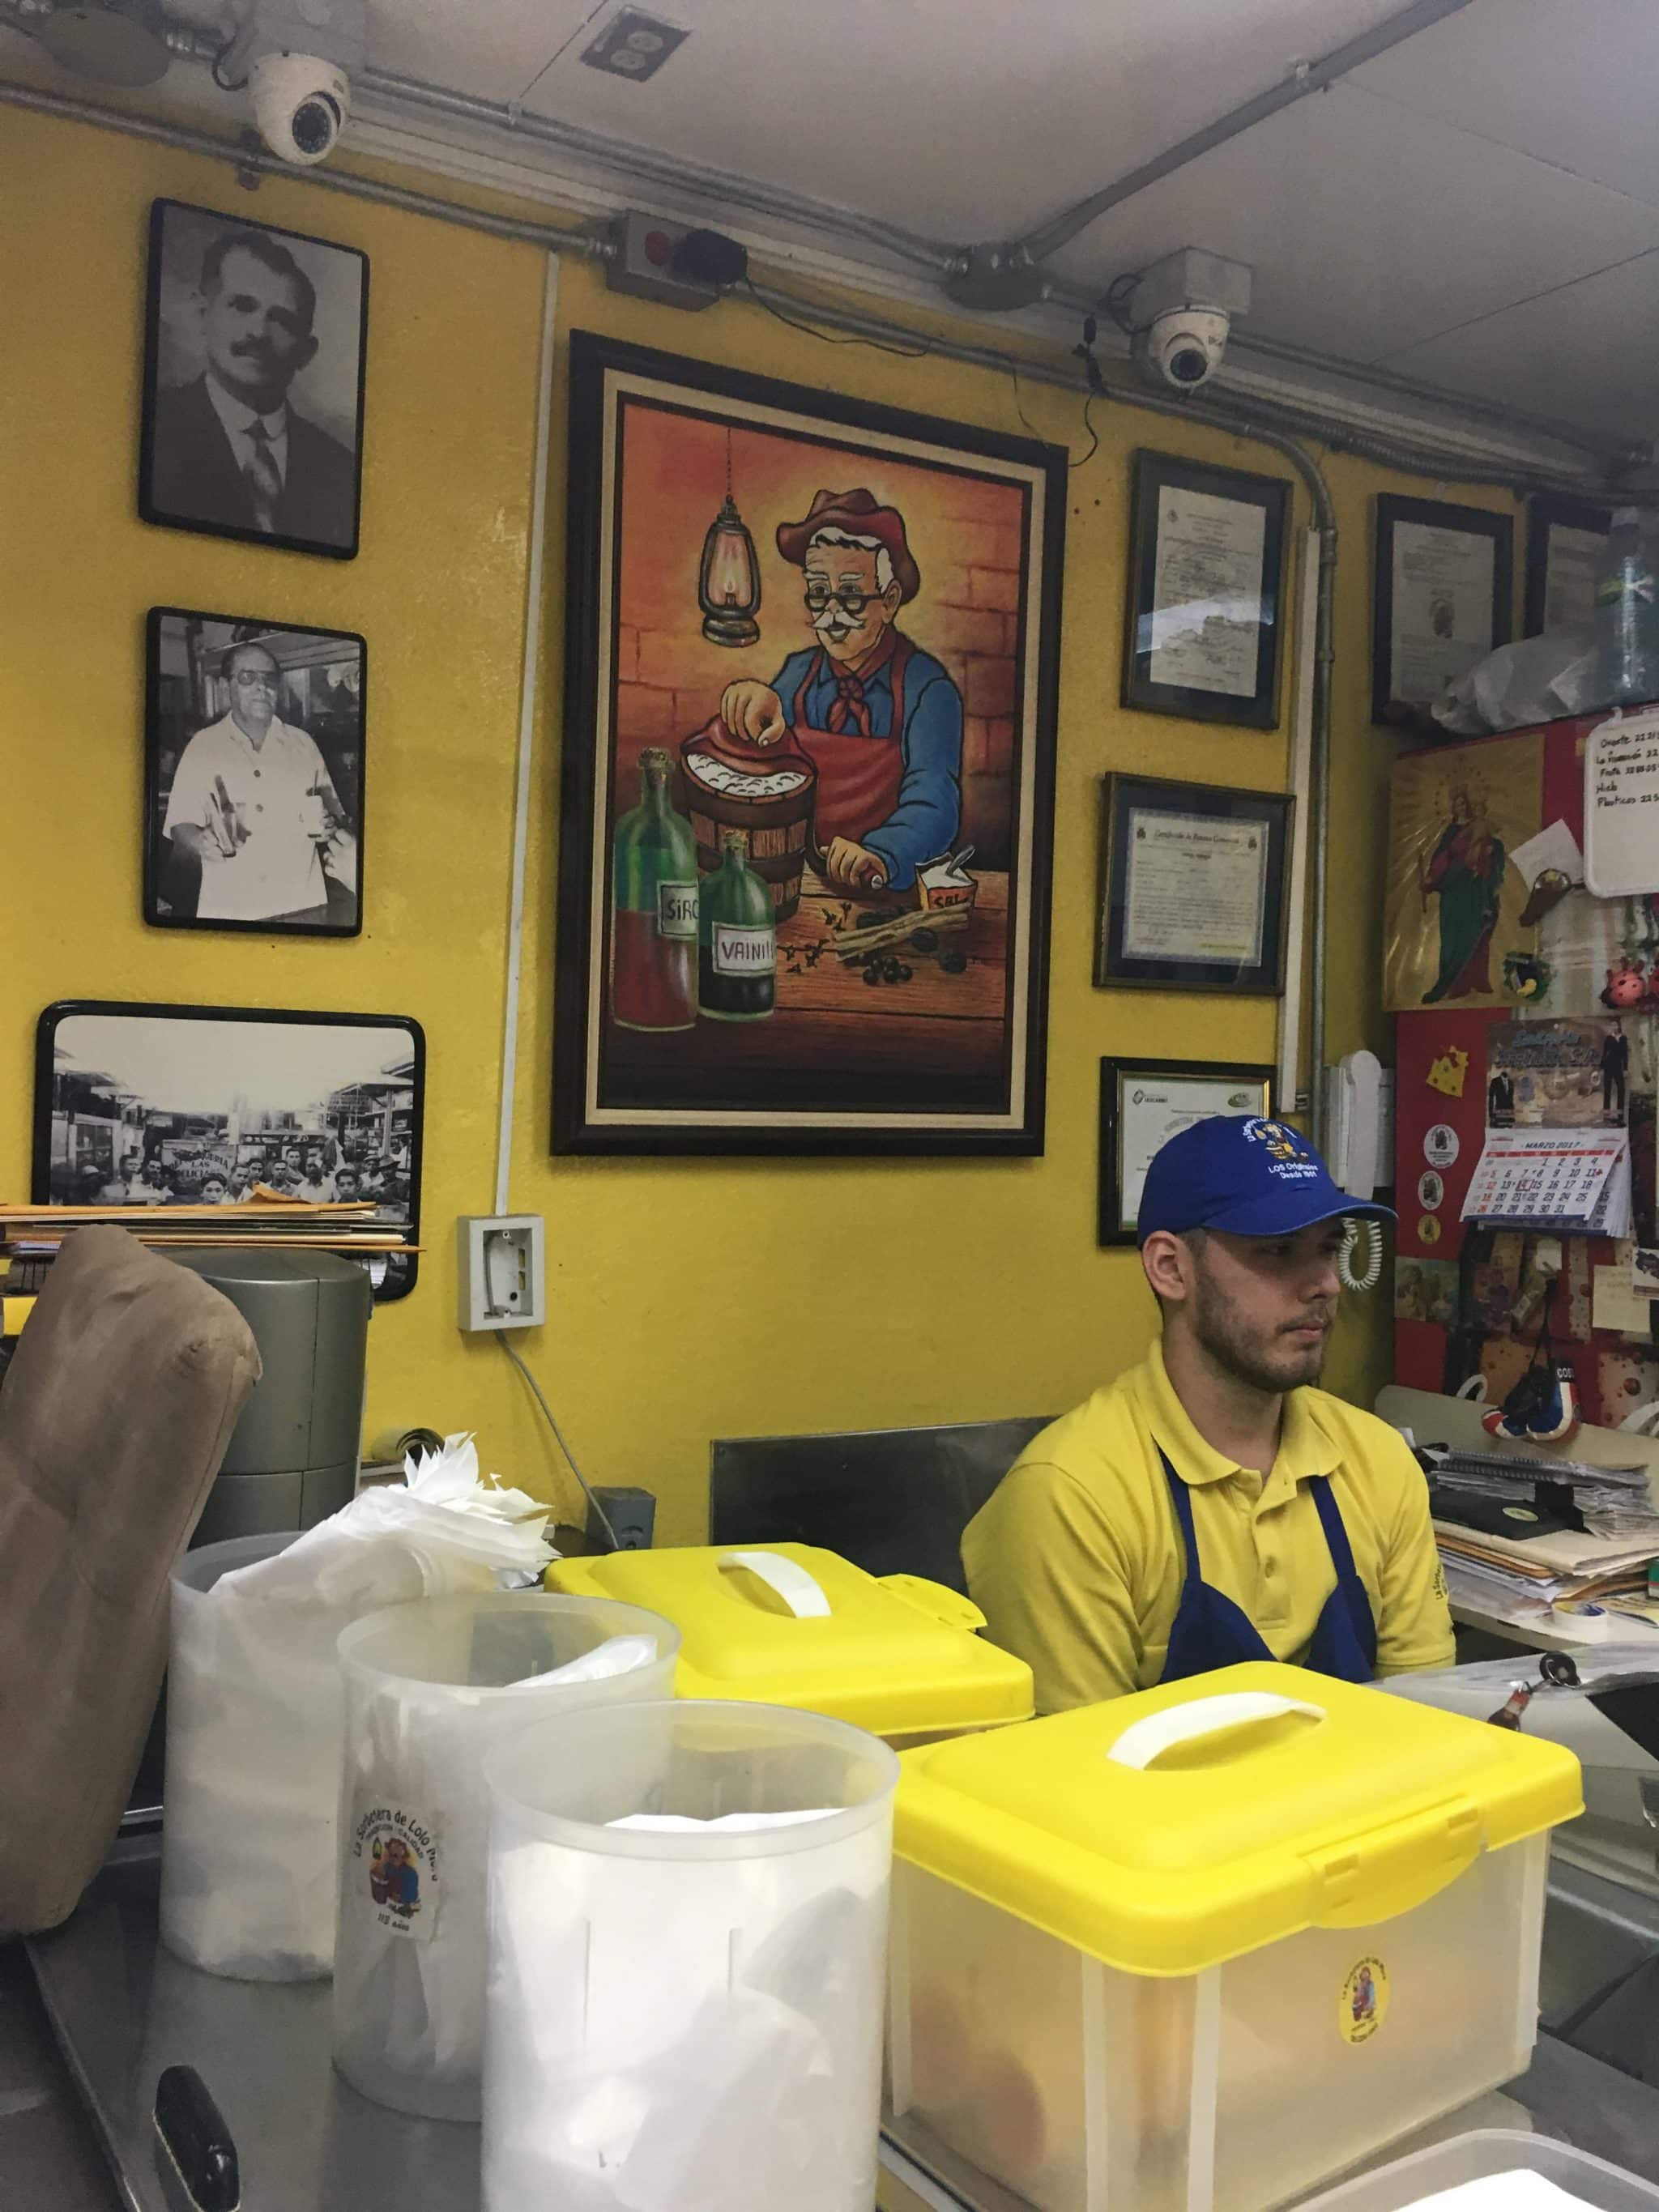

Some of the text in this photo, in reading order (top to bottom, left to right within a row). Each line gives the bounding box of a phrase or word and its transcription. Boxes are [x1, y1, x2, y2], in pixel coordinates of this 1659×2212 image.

[1556, 1141, 1581, 1149] 2017
[1268, 1164, 1286, 1174] LOS
[394, 1810, 407, 1826] de
[408, 1819, 430, 1846] Lolo
